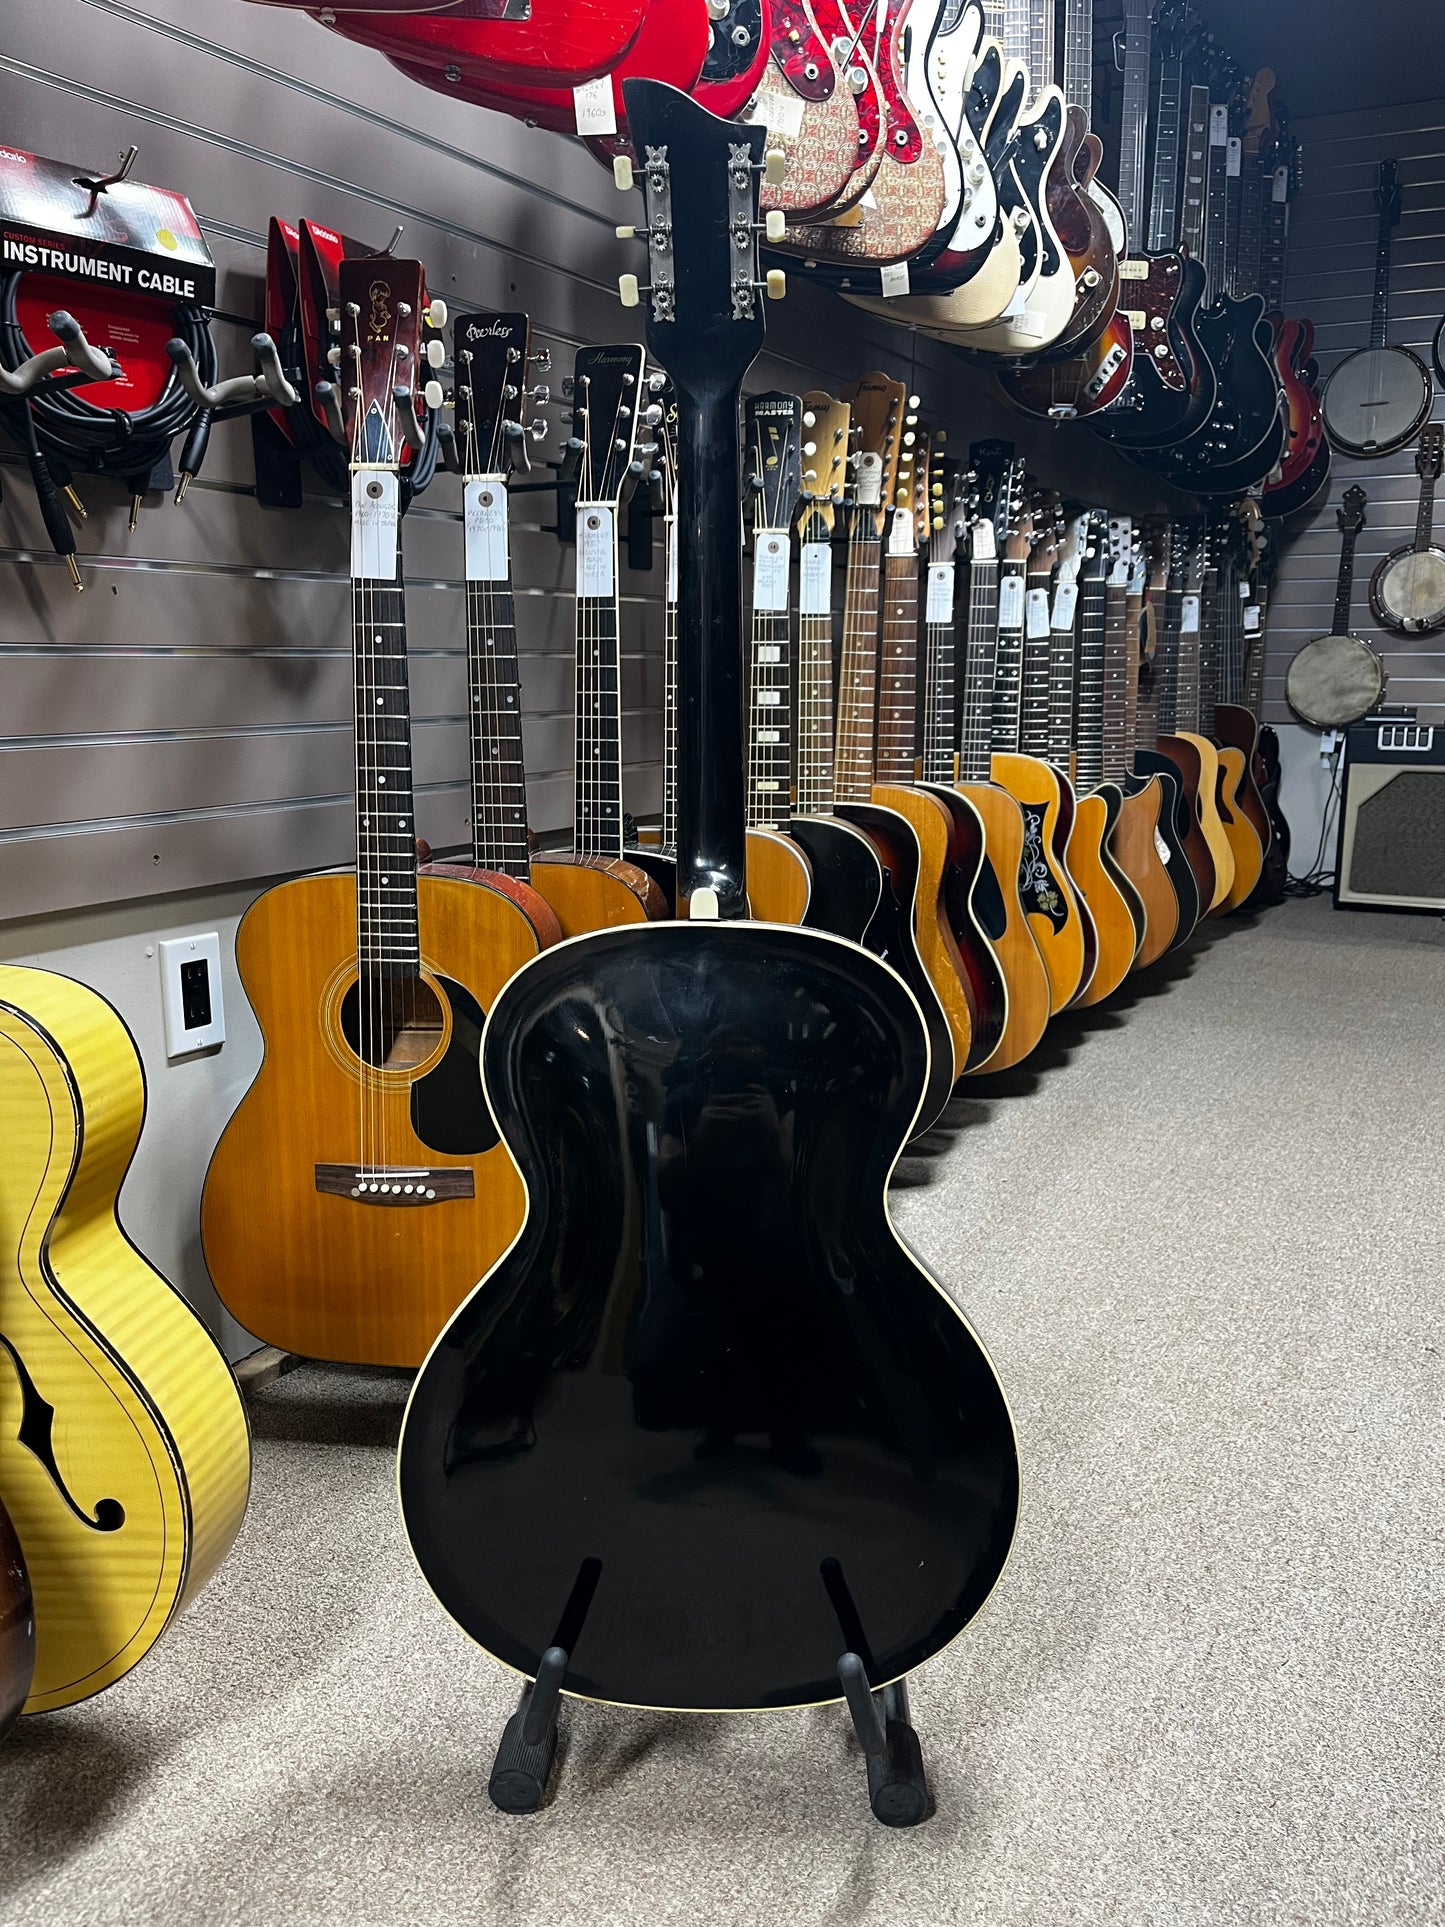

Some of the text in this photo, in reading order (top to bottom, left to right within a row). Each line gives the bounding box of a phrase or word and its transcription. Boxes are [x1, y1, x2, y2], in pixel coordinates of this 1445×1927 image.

[3, 231, 65, 250] CUSTOM SERIES
[3, 240, 195, 299] INSTRUMENT CABLE
[466, 319, 513, 341] Peerless
[587, 351, 633, 366] Harmony
[754, 401, 794, 410] HARMONY
